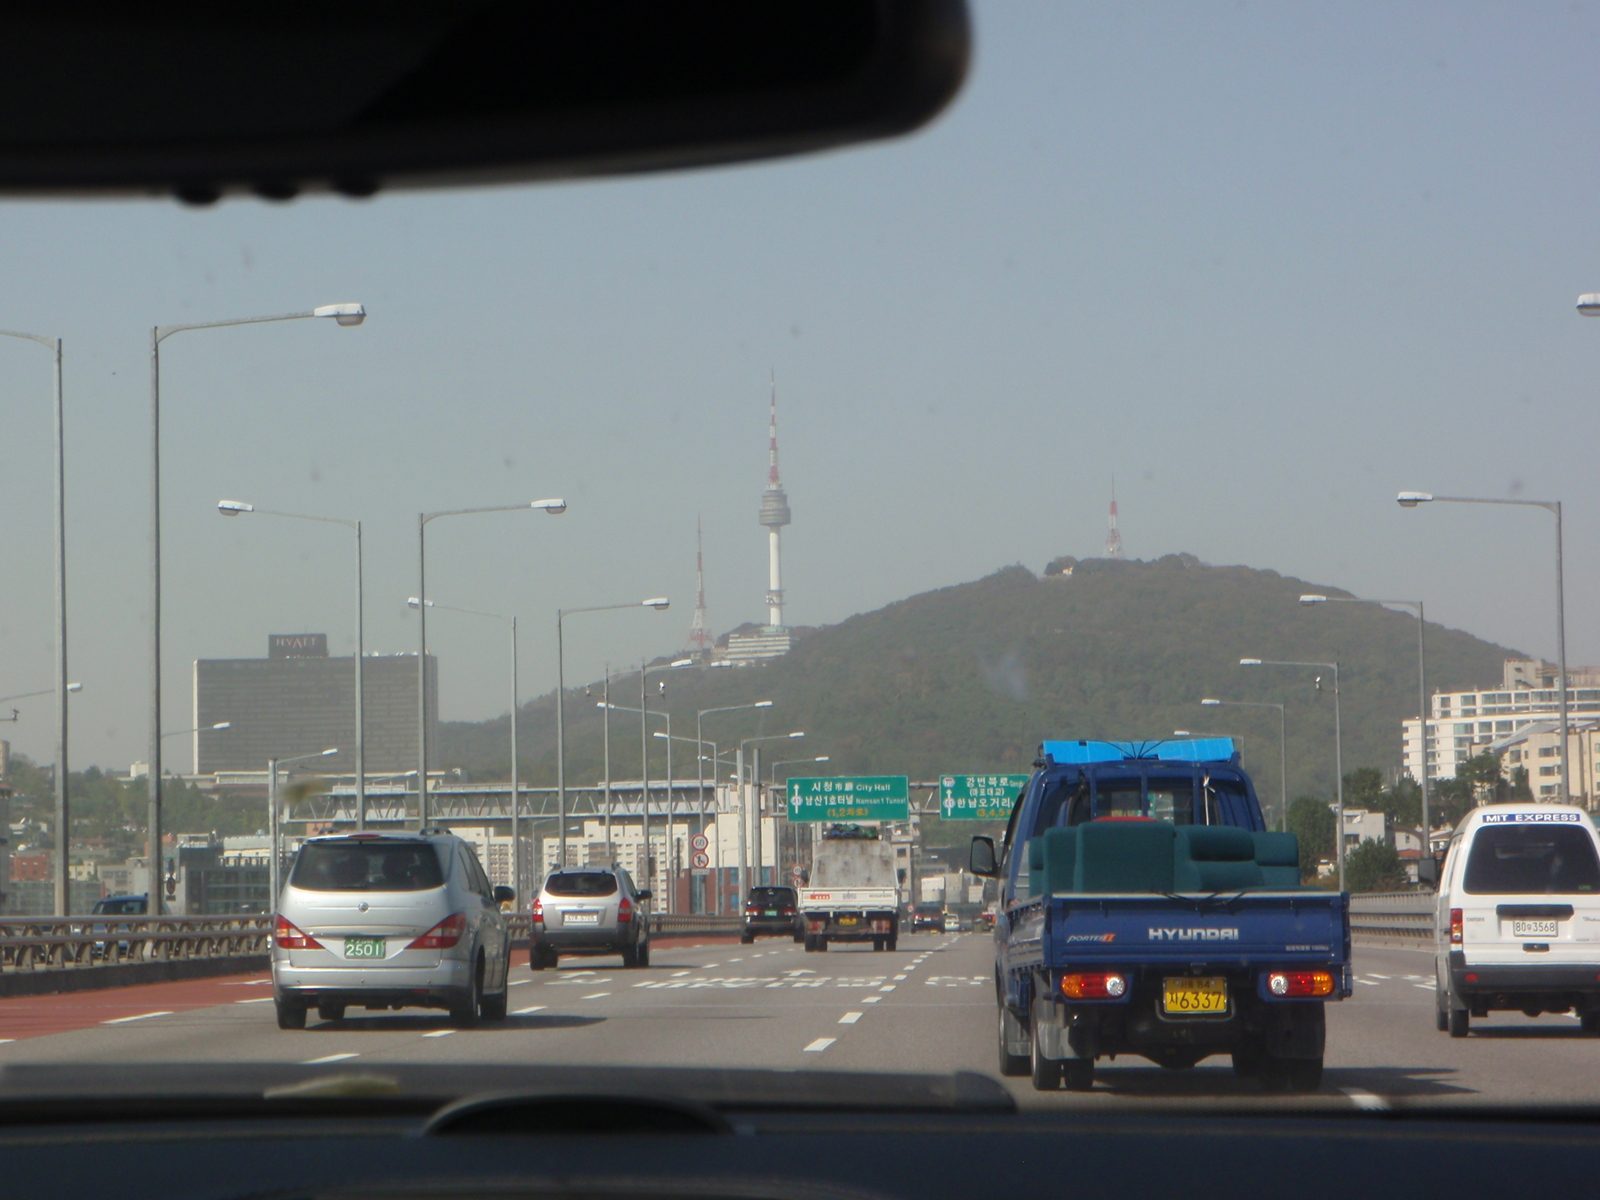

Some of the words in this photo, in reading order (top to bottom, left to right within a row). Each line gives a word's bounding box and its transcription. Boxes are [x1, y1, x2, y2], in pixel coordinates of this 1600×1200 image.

[275, 637, 318, 648] HYATT
[966, 777, 1009, 787] 강변북로
[856, 784, 872, 792] City
[805, 794, 854, 806] 남산1호터널
[957, 798, 1011, 809] 한남오거리
[1486, 814, 1509, 822] MIT
[1515, 813, 1577, 822] EXPRESS
[1148, 928, 1239, 941] HYUNDAI
[345, 943, 380, 957] 2501
